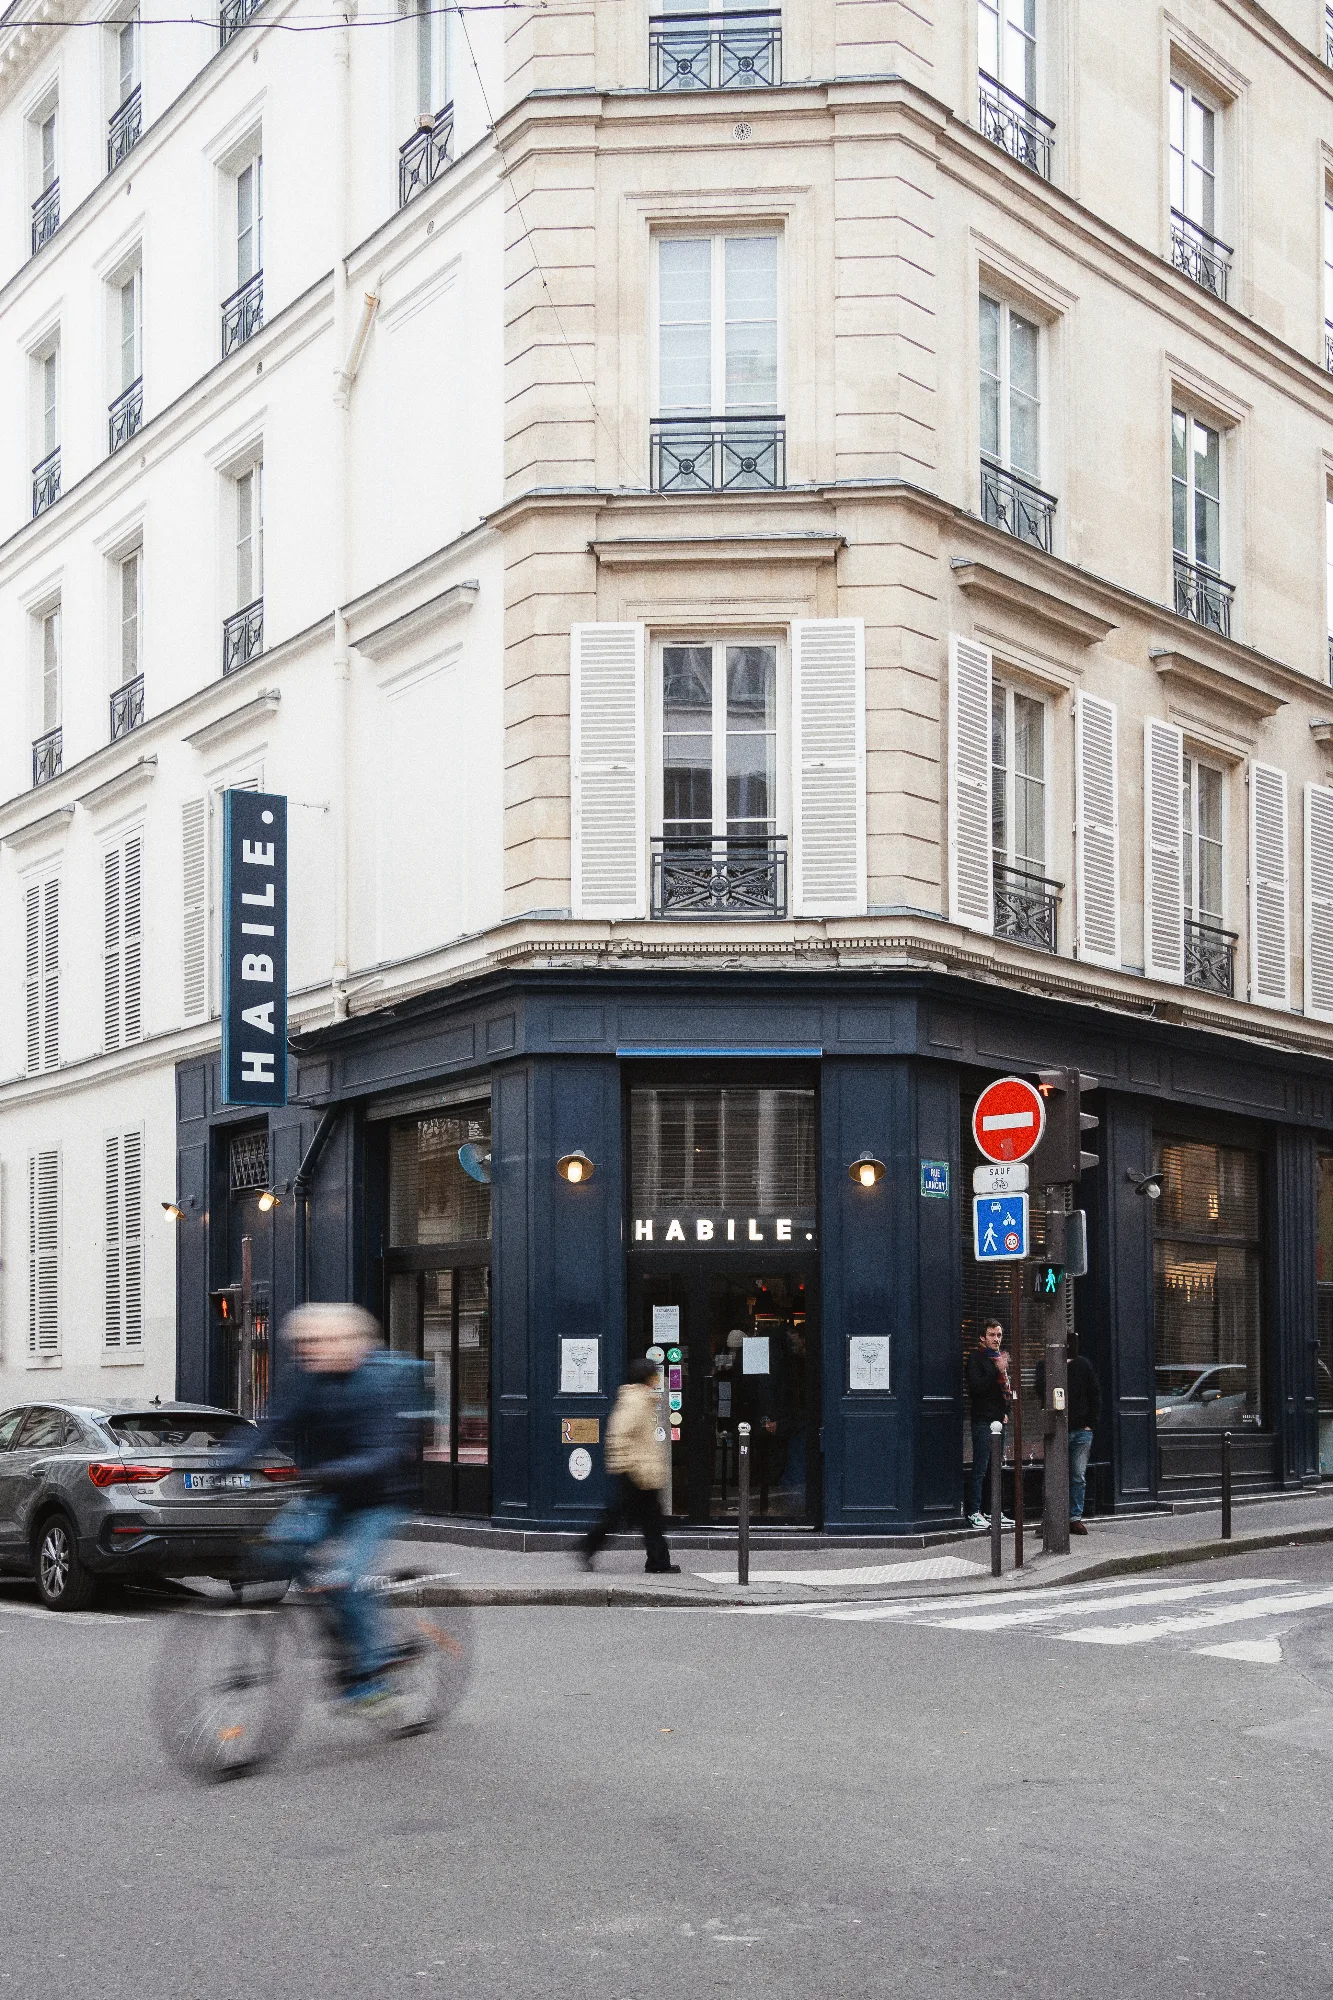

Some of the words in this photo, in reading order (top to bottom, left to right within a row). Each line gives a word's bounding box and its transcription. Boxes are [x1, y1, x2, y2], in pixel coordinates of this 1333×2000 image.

[241, 810, 275, 1083] HABILE.
[930, 1168, 941, 1178] RUE
[989, 1167, 1011, 1176] SAUF
[635, 1218, 812, 1241] HABILE.
[1008, 1238, 1017, 1246] 20
